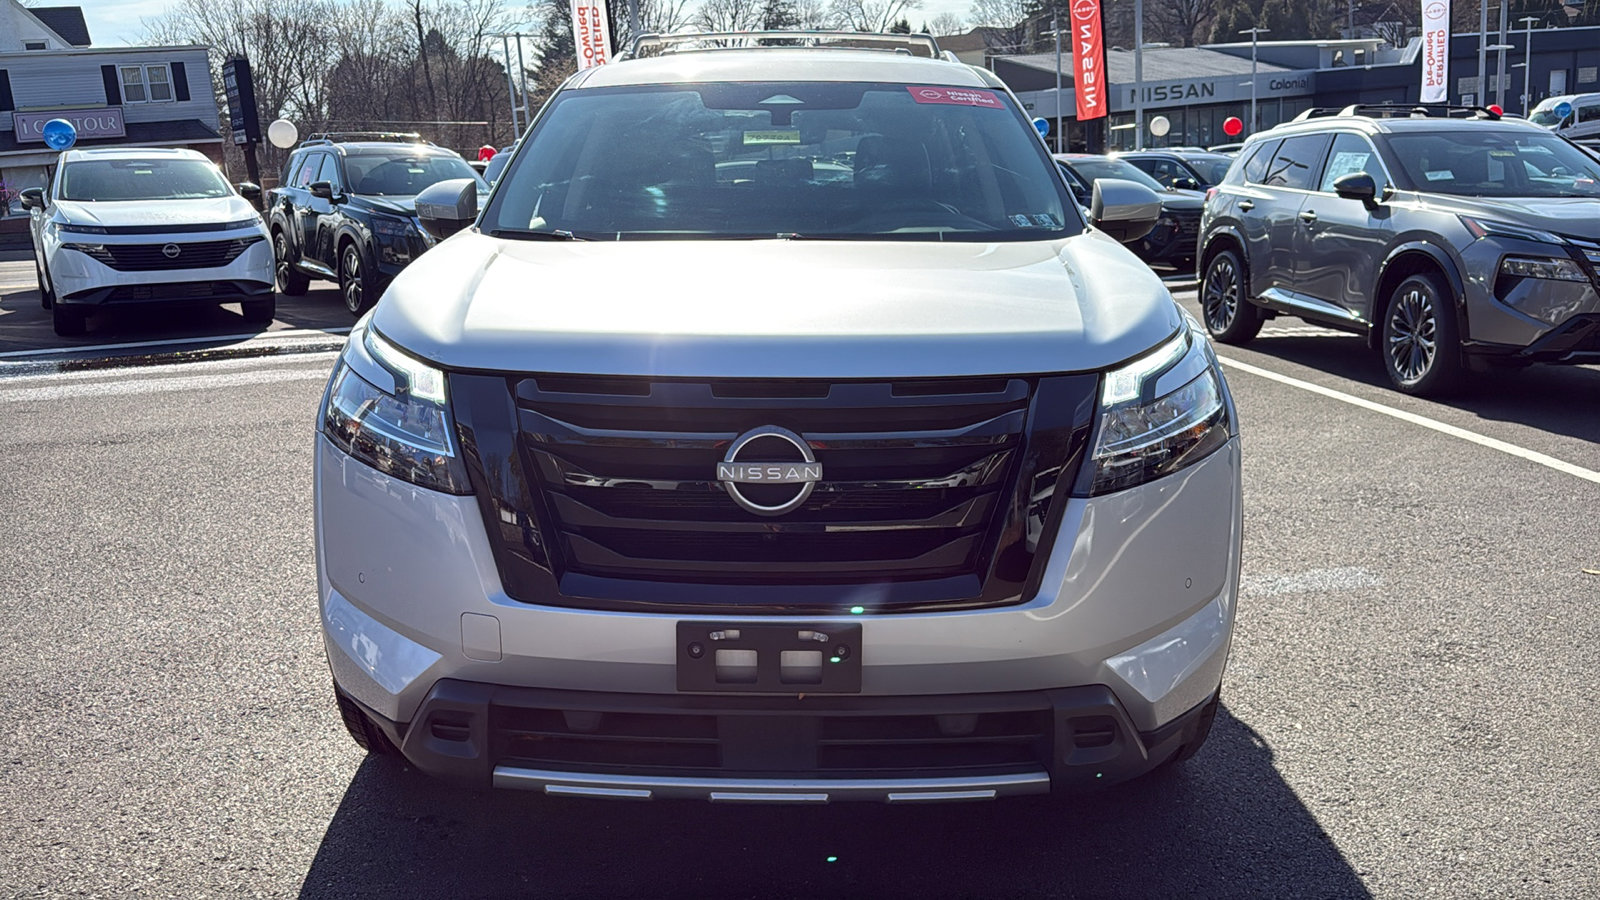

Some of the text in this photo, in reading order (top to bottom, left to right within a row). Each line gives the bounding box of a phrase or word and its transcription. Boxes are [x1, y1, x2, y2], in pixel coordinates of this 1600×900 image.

[1270, 77, 1309, 90] Colonial
[1130, 82, 1215, 103] NISSAN
[33, 116, 117, 134] CTOUR
[720, 466, 819, 480] NISSAN
